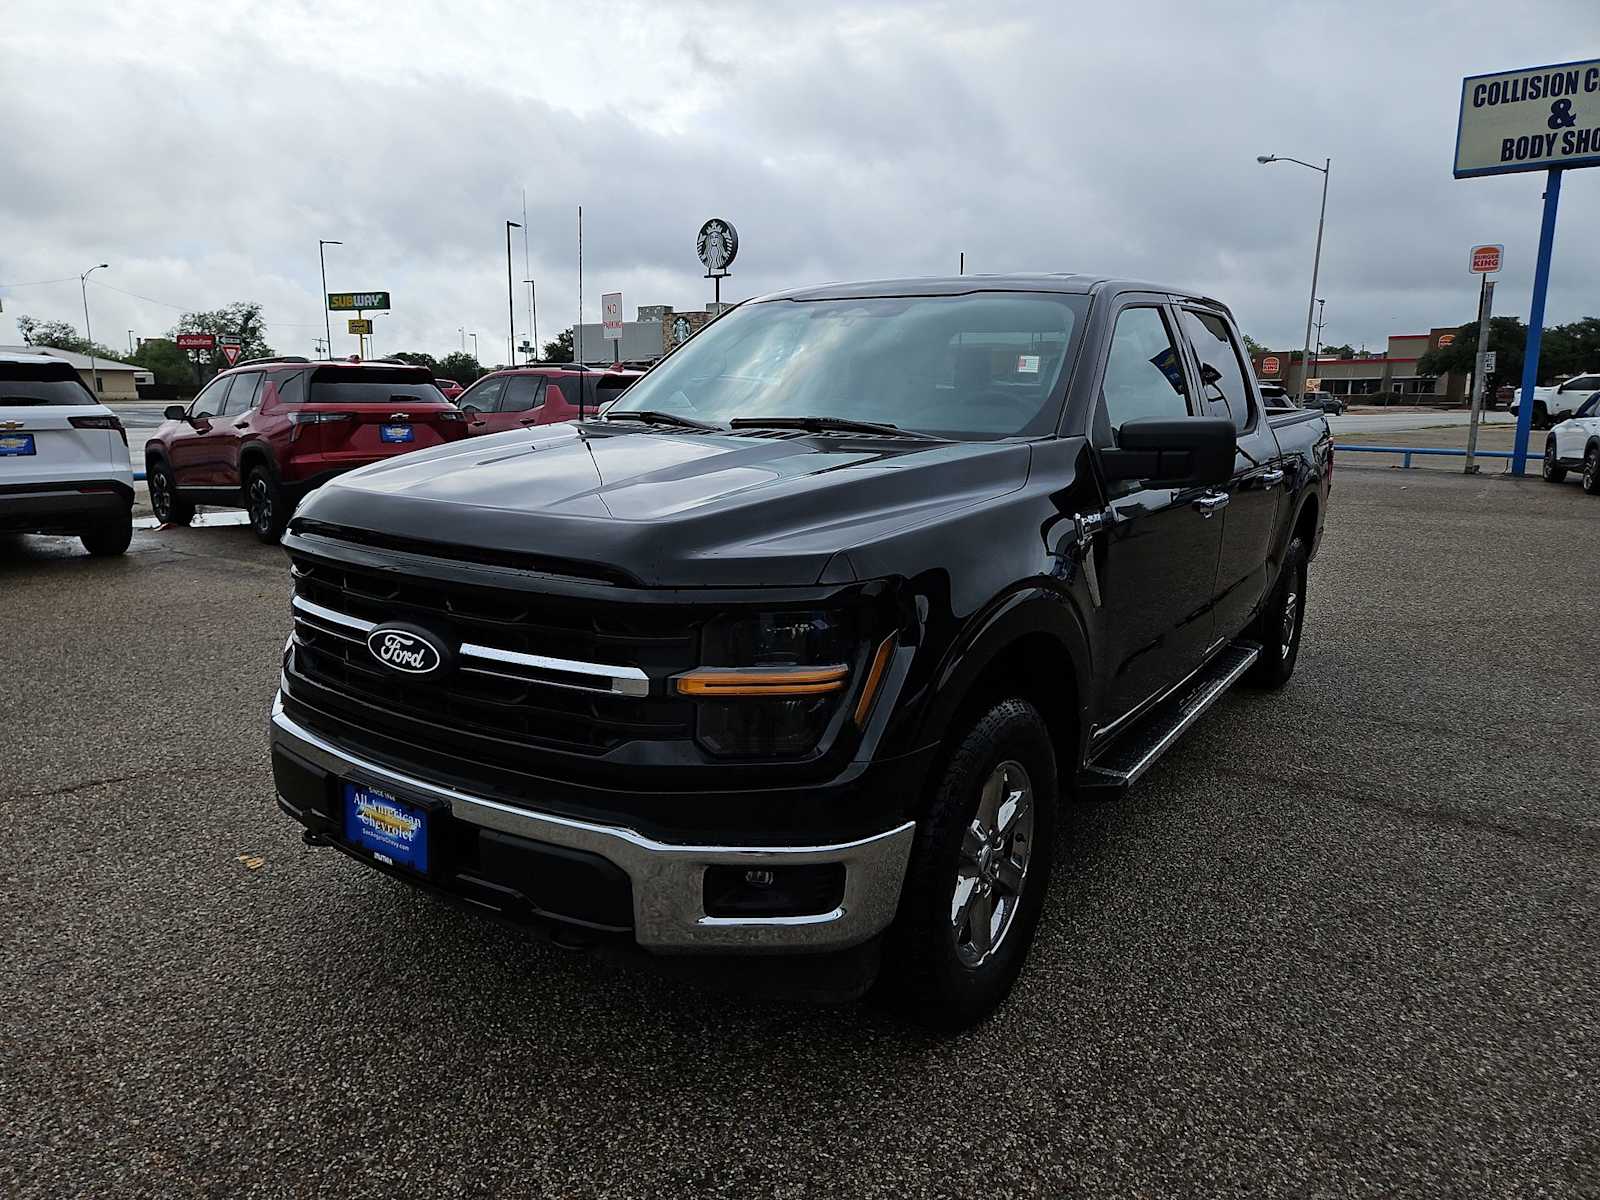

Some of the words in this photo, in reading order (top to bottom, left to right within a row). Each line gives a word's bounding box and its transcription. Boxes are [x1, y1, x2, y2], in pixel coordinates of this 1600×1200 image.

[1473, 70, 1580, 108] COLLISION
[1584, 68, 1600, 93] C
[1547, 98, 1577, 130] &
[1501, 132, 1558, 162] BODY
[1561, 127, 1600, 155] SHO
[1473, 259, 1499, 267] KING
[331, 294, 383, 308] SUBWAY
[608, 304, 616, 314] NO
[381, 634, 426, 669] Ford
[353, 792, 368, 806] All
[372, 800, 421, 828] American
[360, 812, 413, 842] Chevrolet
